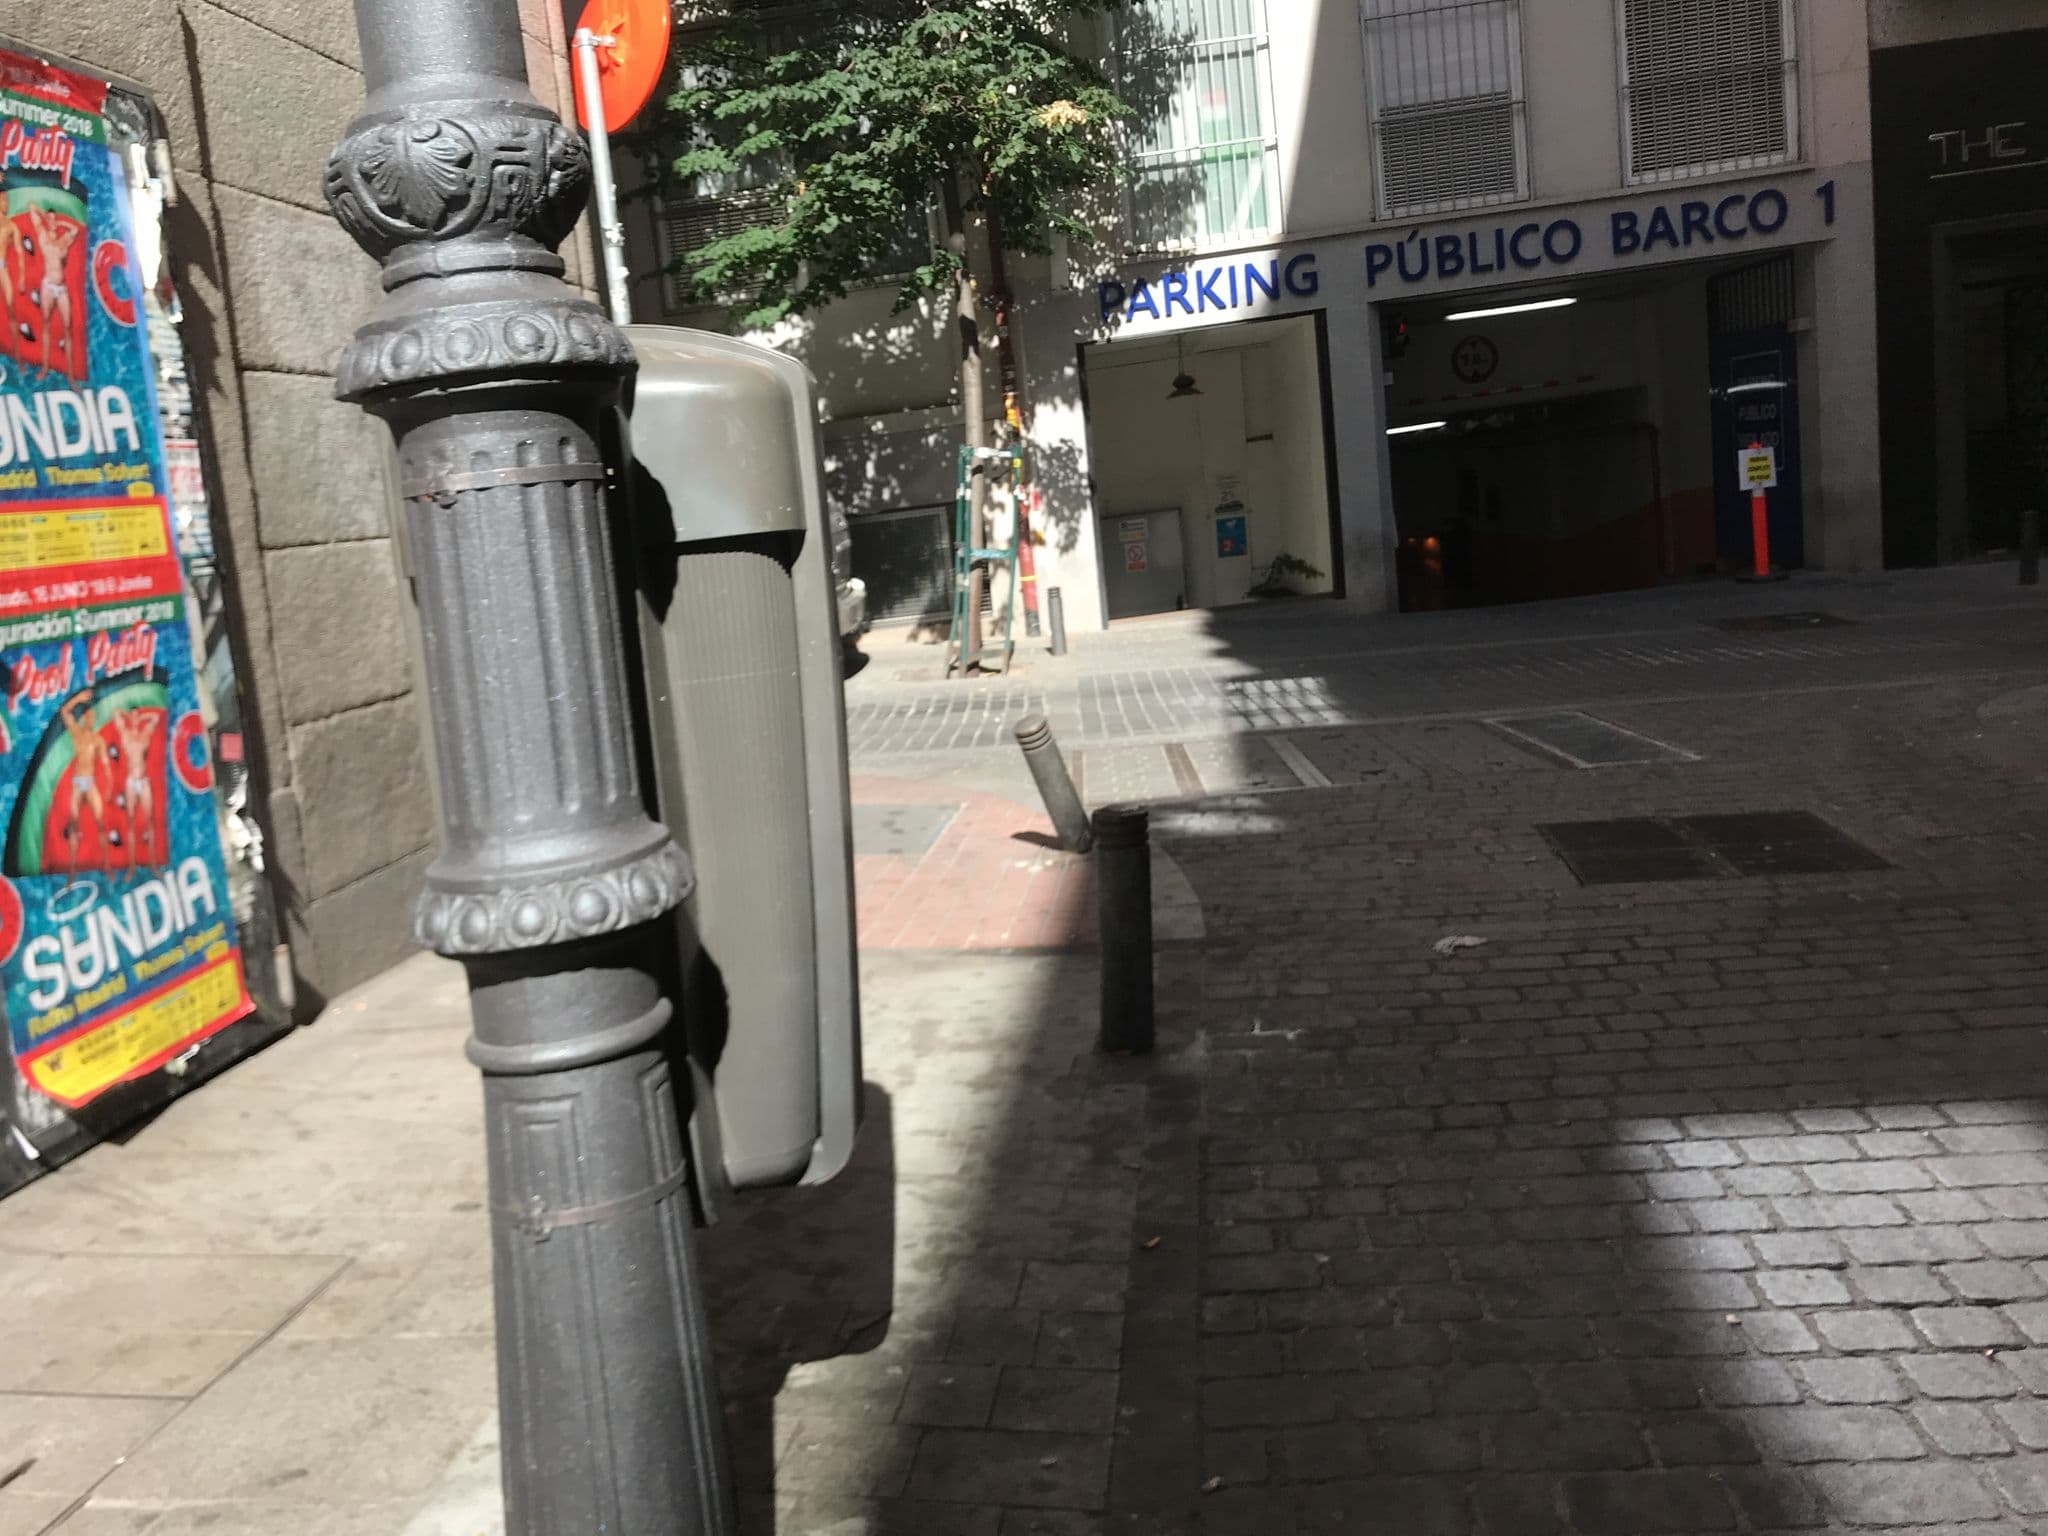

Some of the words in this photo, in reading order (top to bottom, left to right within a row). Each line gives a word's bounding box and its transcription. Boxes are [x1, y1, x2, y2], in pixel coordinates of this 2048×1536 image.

[1929, 122, 2027, 165] THE
[1099, 253, 1319, 323] PARKING
[1364, 219, 1583, 288] PÚBLICO
[1610, 188, 1789, 256] BARCO
[1816, 180, 1836, 227] 1
